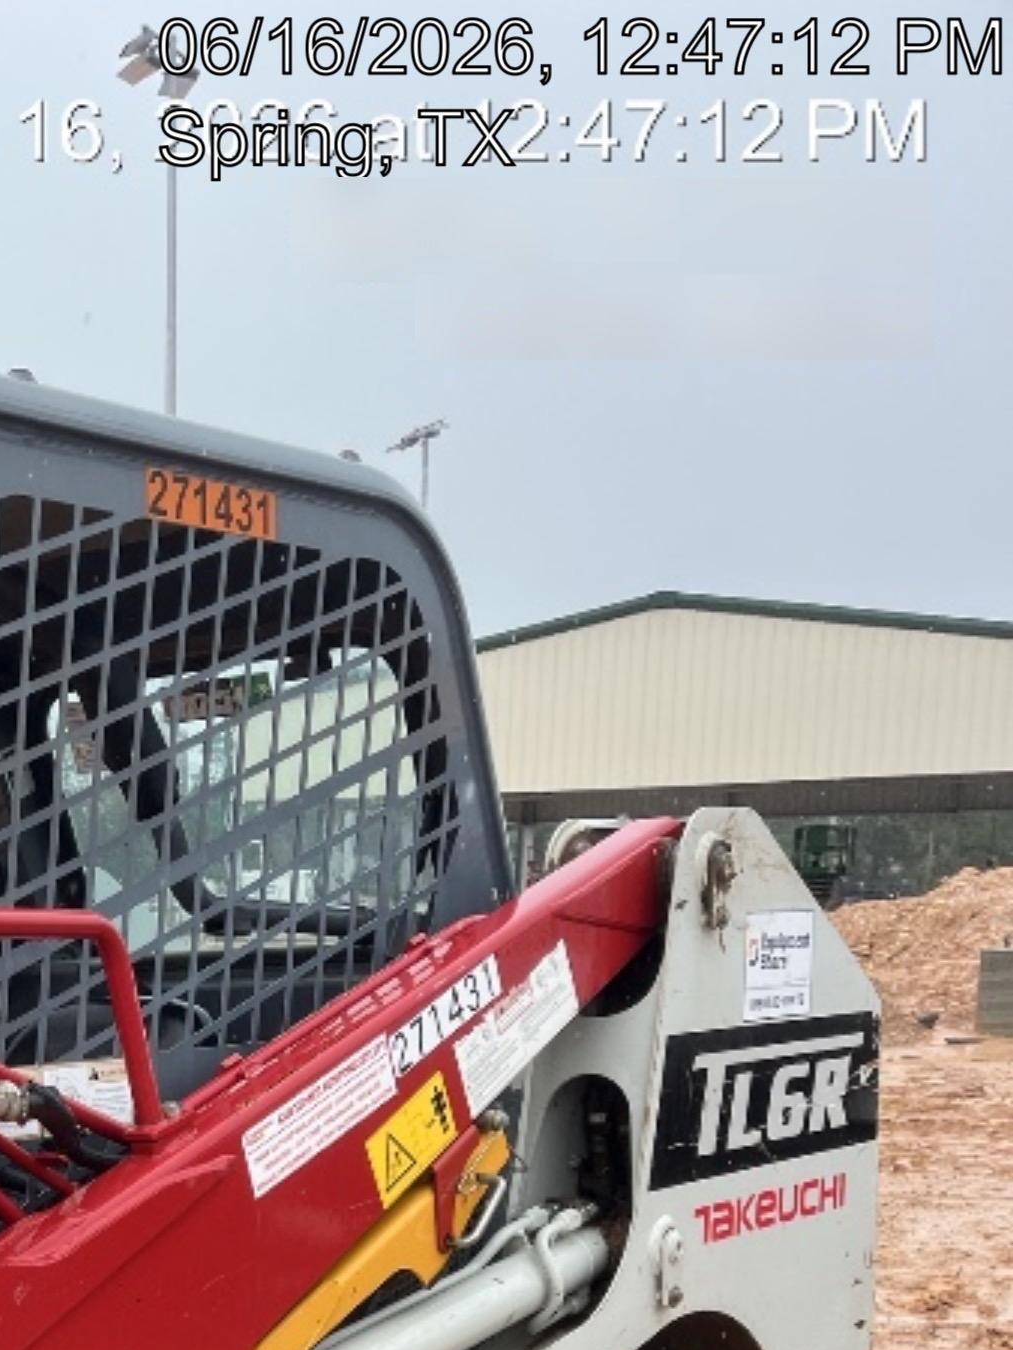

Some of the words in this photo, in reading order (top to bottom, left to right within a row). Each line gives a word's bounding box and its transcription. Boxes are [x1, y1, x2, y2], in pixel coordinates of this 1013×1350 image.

[148, 470, 272, 536] 271431
[393, 962, 497, 1074] 271431
[692, 1031, 864, 1157] TL6R
[693, 1173, 847, 1244] TAKEUCHI
